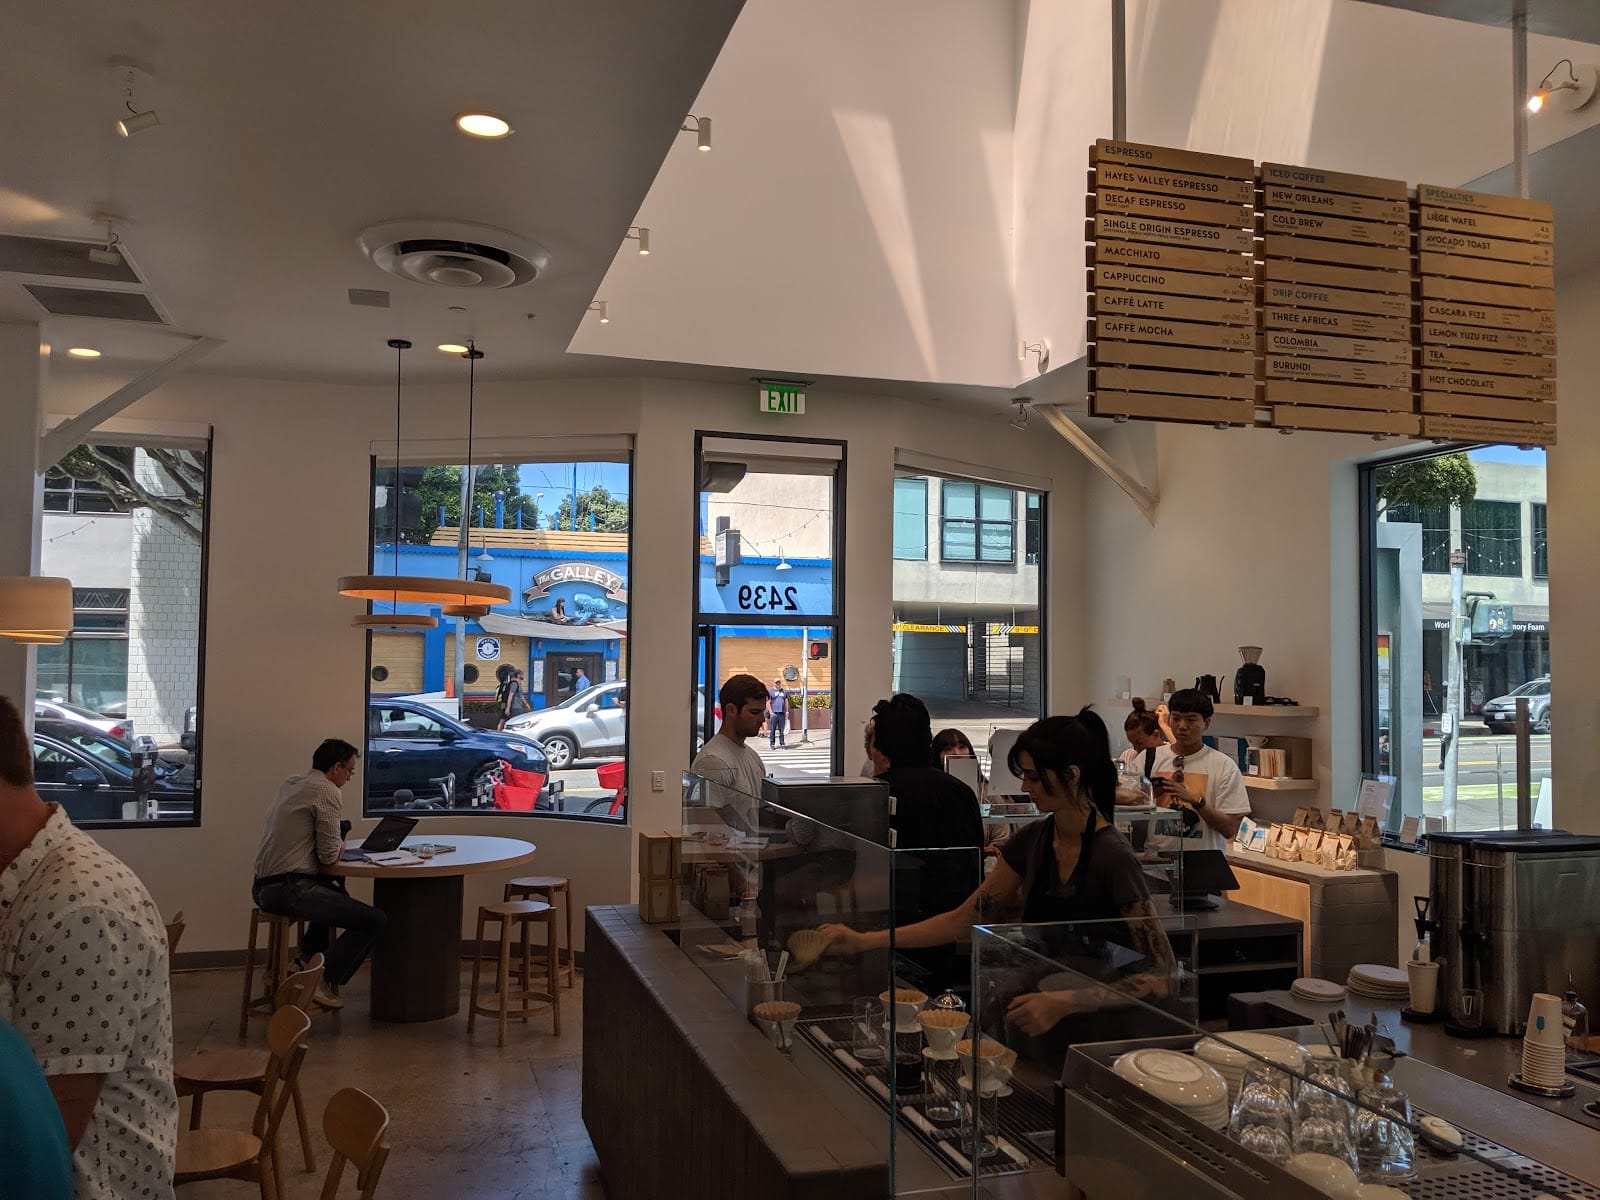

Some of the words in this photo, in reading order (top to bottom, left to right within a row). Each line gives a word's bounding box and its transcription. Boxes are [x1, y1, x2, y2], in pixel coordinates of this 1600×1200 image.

[1105, 146, 1152, 160] ESPRESSO
[1105, 170, 1134, 182] HAYES
[1137, 174, 1170, 186] VALLEY
[1172, 179, 1219, 192] ESPRESSO
[1269, 168, 1290, 178] ICED
[1292, 172, 1326, 183] COFFEE
[1105, 194, 1136, 204] DECAF
[1139, 198, 1186, 211] ESPRESSO
[1272, 192, 1294, 200] NEW
[1295, 194, 1334, 206] ORLEANS
[1426, 188, 1474, 203] SPECIALTIES
[1272, 214, 1296, 225] COLD
[1298, 218, 1324, 228] BREW
[1451, 217, 1477, 227] WAFEL
[1103, 219, 1136, 230] SINGLE
[1139, 223, 1171, 234] ORIGIN
[1174, 227, 1220, 240] ESPRESSO
[1426, 235, 1465, 247] AVOCADO
[1468, 240, 1490, 250] TOAST
[1104, 247, 1160, 260] MACCHIATO
[1103, 271, 1165, 285] CAPPUCCINO
[1272, 288, 1293, 297] DRIP
[1295, 291, 1329, 301] COFFEE
[1138, 300, 1165, 310] LATTE
[1272, 312, 1299, 323] THREE
[1302, 316, 1338, 326] AFRICAS
[1429, 306, 1467, 318] CASCARA
[1469, 311, 1486, 320] FIZZ
[1138, 326, 1174, 337] MOCHA
[1429, 328, 1458, 339] LEMON
[1460, 332, 1480, 340] YUZU
[1481, 334, 1499, 343] FIZZ
[1273, 336, 1319, 348] COLOMBIA
[1430, 350, 1444, 359] TEA
[1273, 361, 1311, 371] BURUNDI
[1430, 376, 1446, 385] HOT
[1447, 377, 1496, 389] CHOCOLATE
[768, 389, 798, 413] EXIT
[538, 574, 550, 584] The
[550, 566, 618, 586] GALLEY
[1434, 620, 1450, 629] Worl
[1512, 624, 1527, 632] mory
[1528, 623, 1545, 631] Foam
